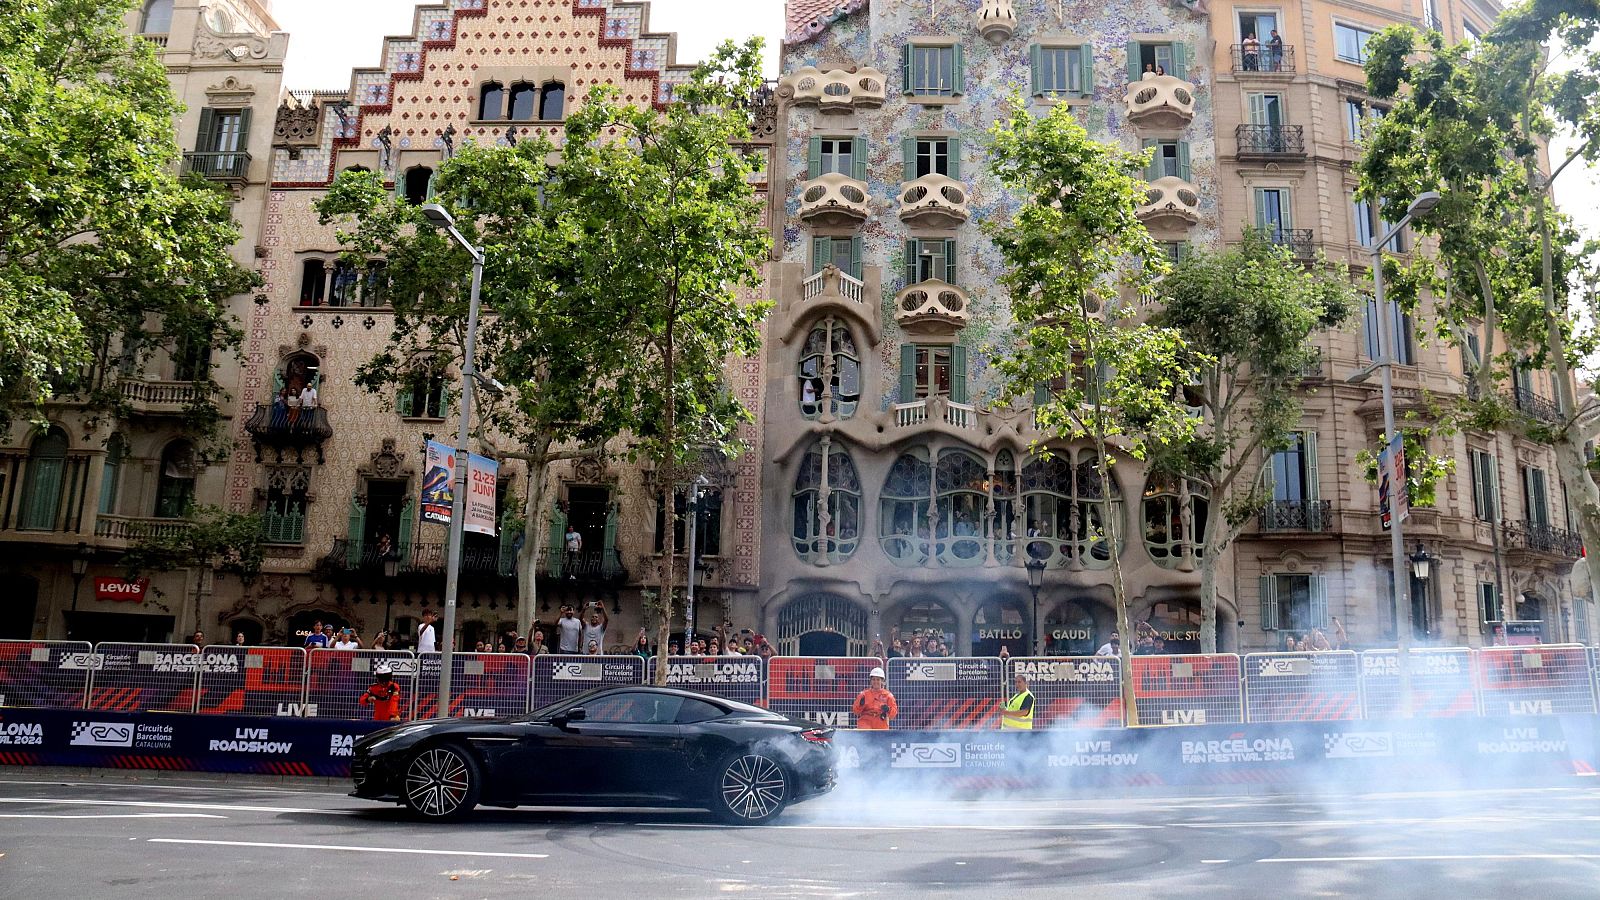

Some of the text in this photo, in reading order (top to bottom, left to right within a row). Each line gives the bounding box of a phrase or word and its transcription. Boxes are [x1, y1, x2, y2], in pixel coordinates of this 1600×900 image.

[472, 482, 494, 498] JUNY
[980, 626, 1022, 640] BATLLÓ
[1052, 627, 1091, 640] GAUDÍ
[1088, 673, 1114, 681] 2024
[276, 703, 318, 717] LIVE
[1508, 700, 1552, 714] LIVE
[1162, 710, 1206, 724] LIVE
[236, 728, 268, 740] LIVE
[1504, 727, 1538, 738] LIVE
[14, 736, 42, 744] 2024
[1076, 741, 1111, 752] LIVE
[1182, 738, 1294, 754] BARCELONA
[209, 740, 292, 754] ROADSHOW
[330, 747, 352, 756] FAN
[1478, 740, 1567, 754] ROADSHOW
[1048, 754, 1138, 767] ROADSHOW
[1182, 751, 1294, 763] FAN FESTIVAL 2024
